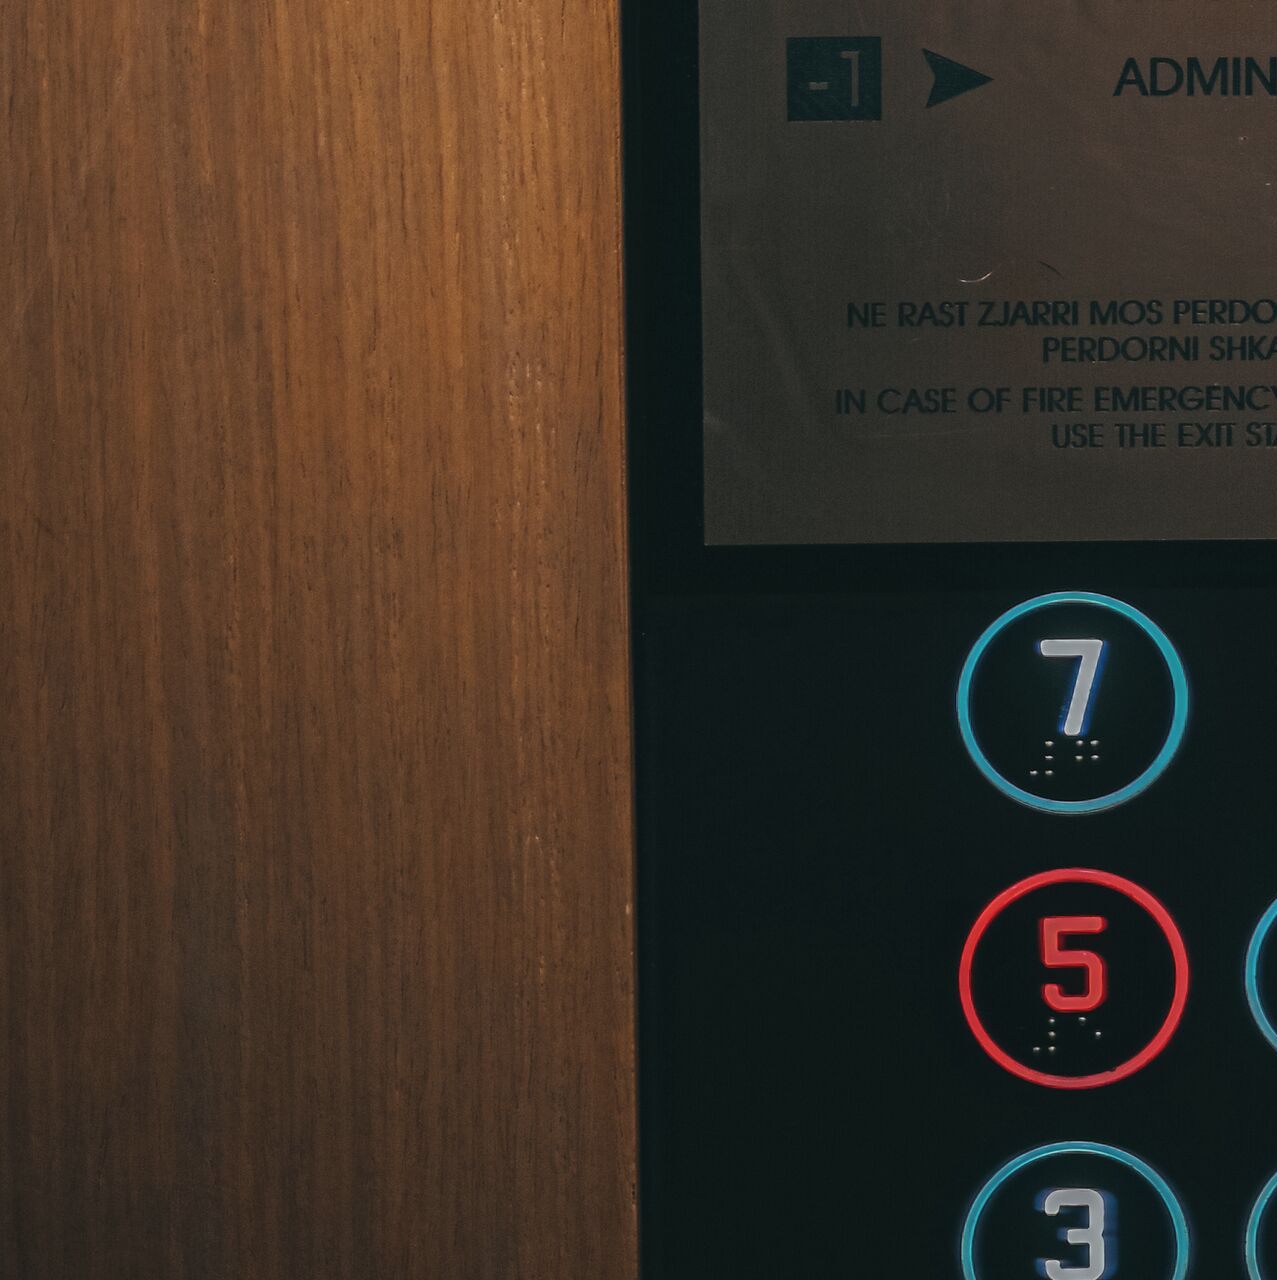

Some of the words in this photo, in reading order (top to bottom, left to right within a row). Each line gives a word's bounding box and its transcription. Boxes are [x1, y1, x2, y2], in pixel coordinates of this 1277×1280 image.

[808, 49, 861, 108] -1
[846, 301, 886, 328] NE
[897, 300, 970, 328] RAST
[977, 299, 1079, 328] ZJARRI
[1089, 299, 1164, 326] MOS
[1042, 335, 1199, 364] PERDORNI
[834, 388, 867, 415] IN
[876, 386, 957, 415] CASE
[966, 386, 1011, 414] OF
[1021, 386, 1083, 414] FIRE
[1051, 422, 1104, 449] USE
[1114, 422, 1166, 448] THE
[1177, 422, 1237, 448] EXIT
[1039, 638, 1104, 737] 7
[1041, 916, 1106, 1011] 5
[1043, 1187, 1106, 1280] 3
